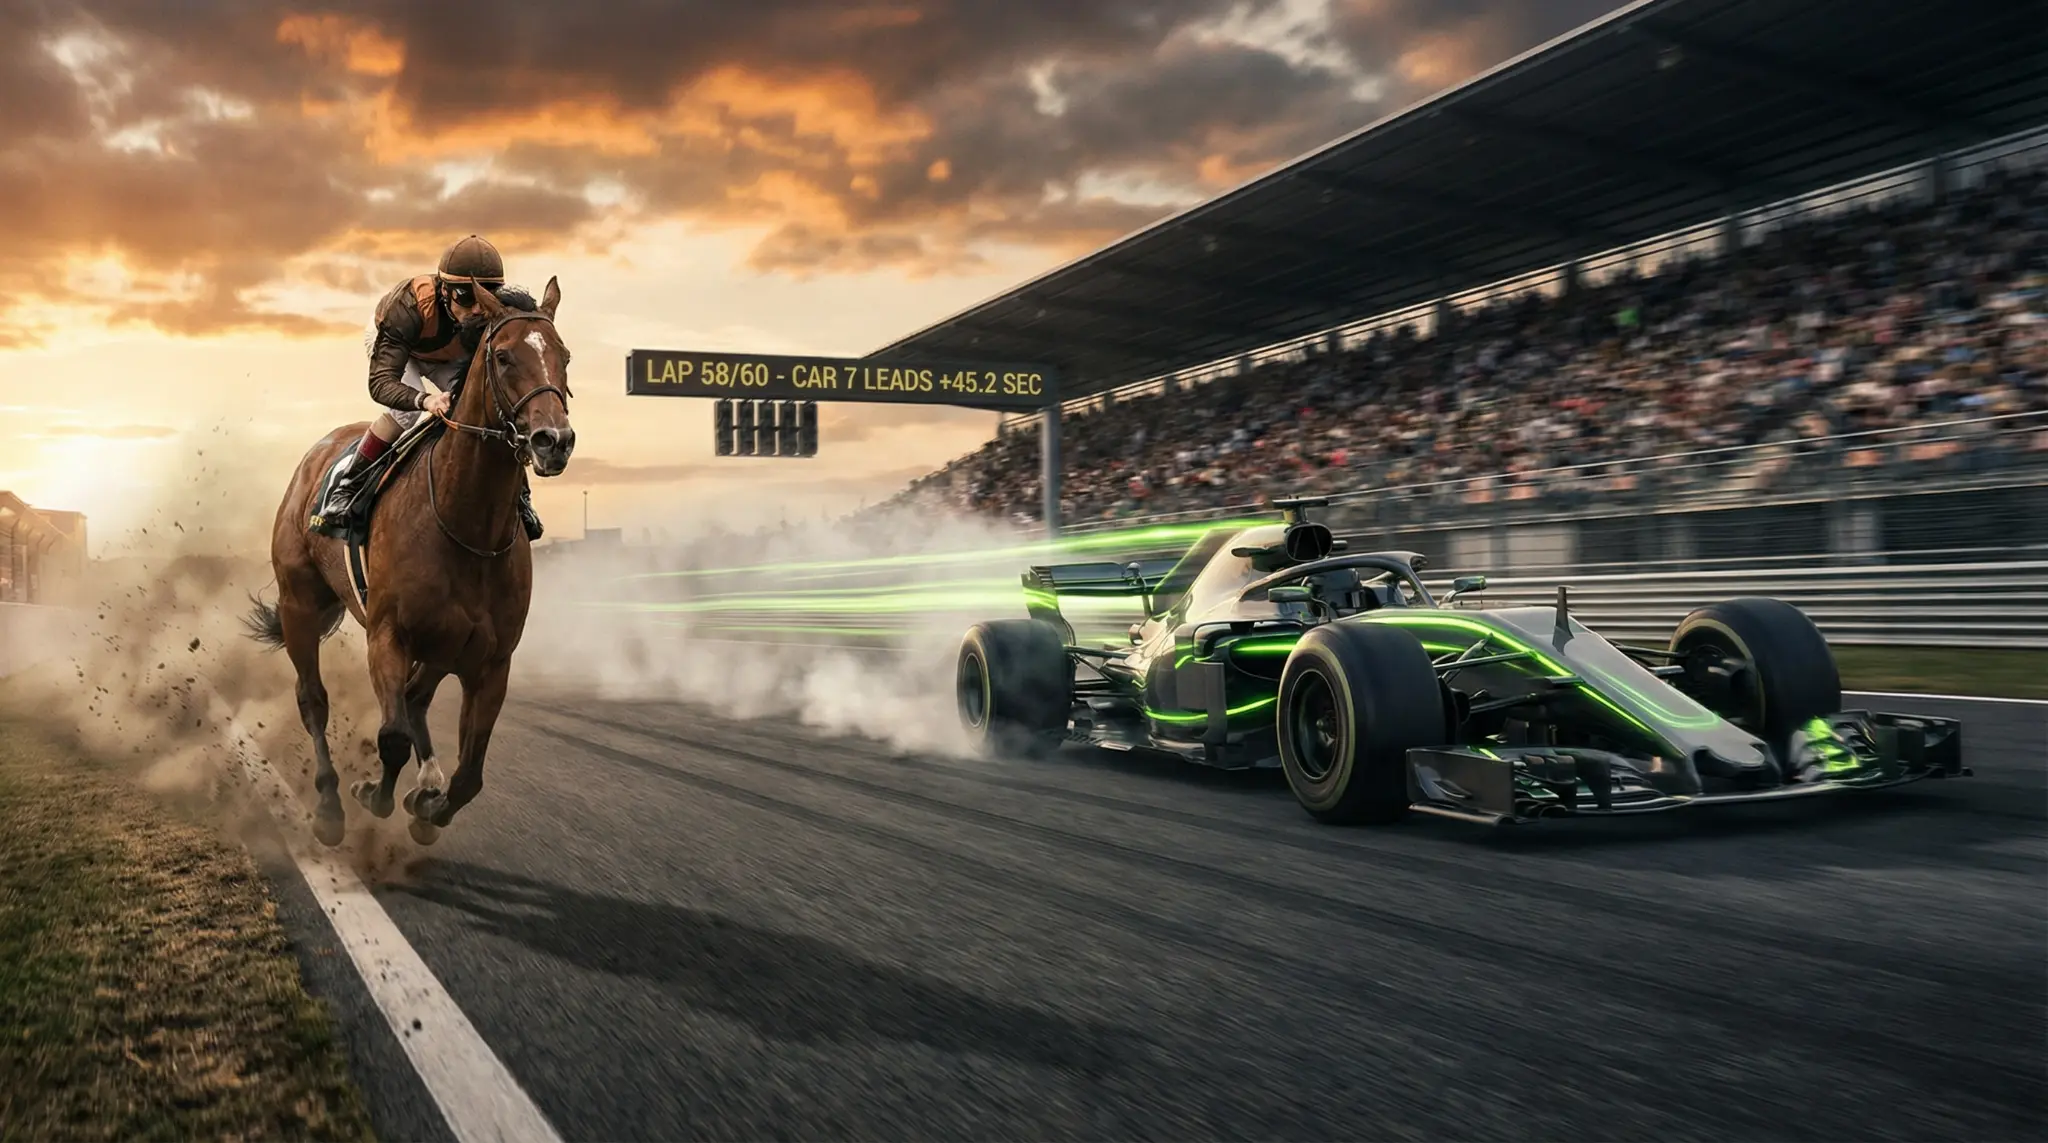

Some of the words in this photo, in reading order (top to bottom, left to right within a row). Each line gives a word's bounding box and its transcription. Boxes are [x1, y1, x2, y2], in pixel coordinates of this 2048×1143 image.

[646, 358, 694, 385] LAP
[700, 361, 769, 388] 58/60
[792, 364, 837, 390] CAR
[844, 366, 857, 390] 7
[864, 367, 933, 392] LEADS
[939, 371, 997, 394] +45.2
[1003, 372, 1042, 396] SEC
